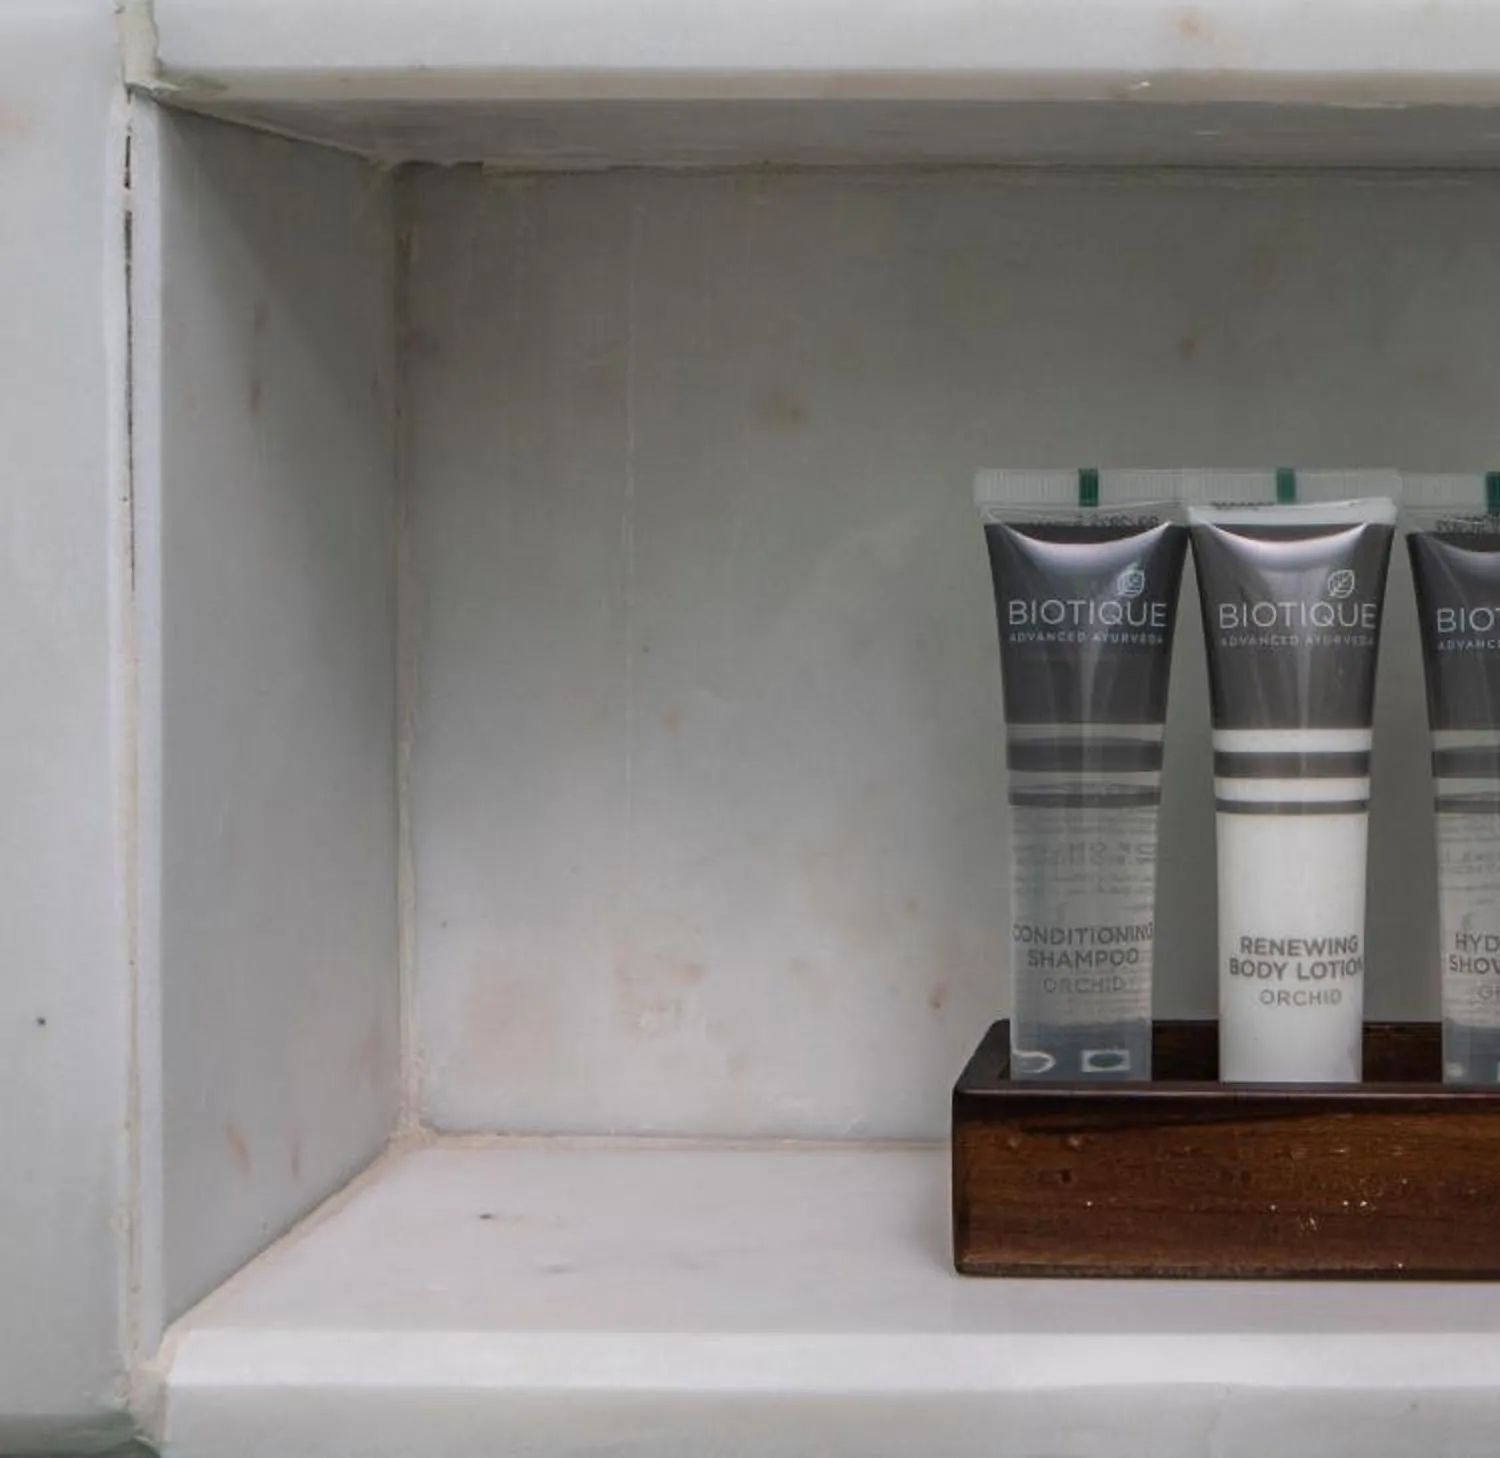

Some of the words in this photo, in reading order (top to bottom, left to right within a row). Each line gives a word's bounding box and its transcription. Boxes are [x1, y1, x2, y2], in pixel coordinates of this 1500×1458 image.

[1008, 598, 1168, 627] BIOTIQUE
[1218, 601, 1378, 629] BIOTIQUE
[1009, 631, 1086, 643] ADVANCED
[1091, 631, 1164, 644] AYURVEDA
[1220, 634, 1299, 647] ADVANCED
[1305, 633, 1375, 646] AYURVEDA
[1012, 921, 1153, 946] CONDITIONING
[1240, 935, 1359, 957] RENEWING
[1027, 948, 1139, 969] SHAMPOO
[1228, 956, 1288, 980] BODY
[1043, 975, 1126, 994] ORCHID
[1260, 988, 1342, 1007] ORCHID
